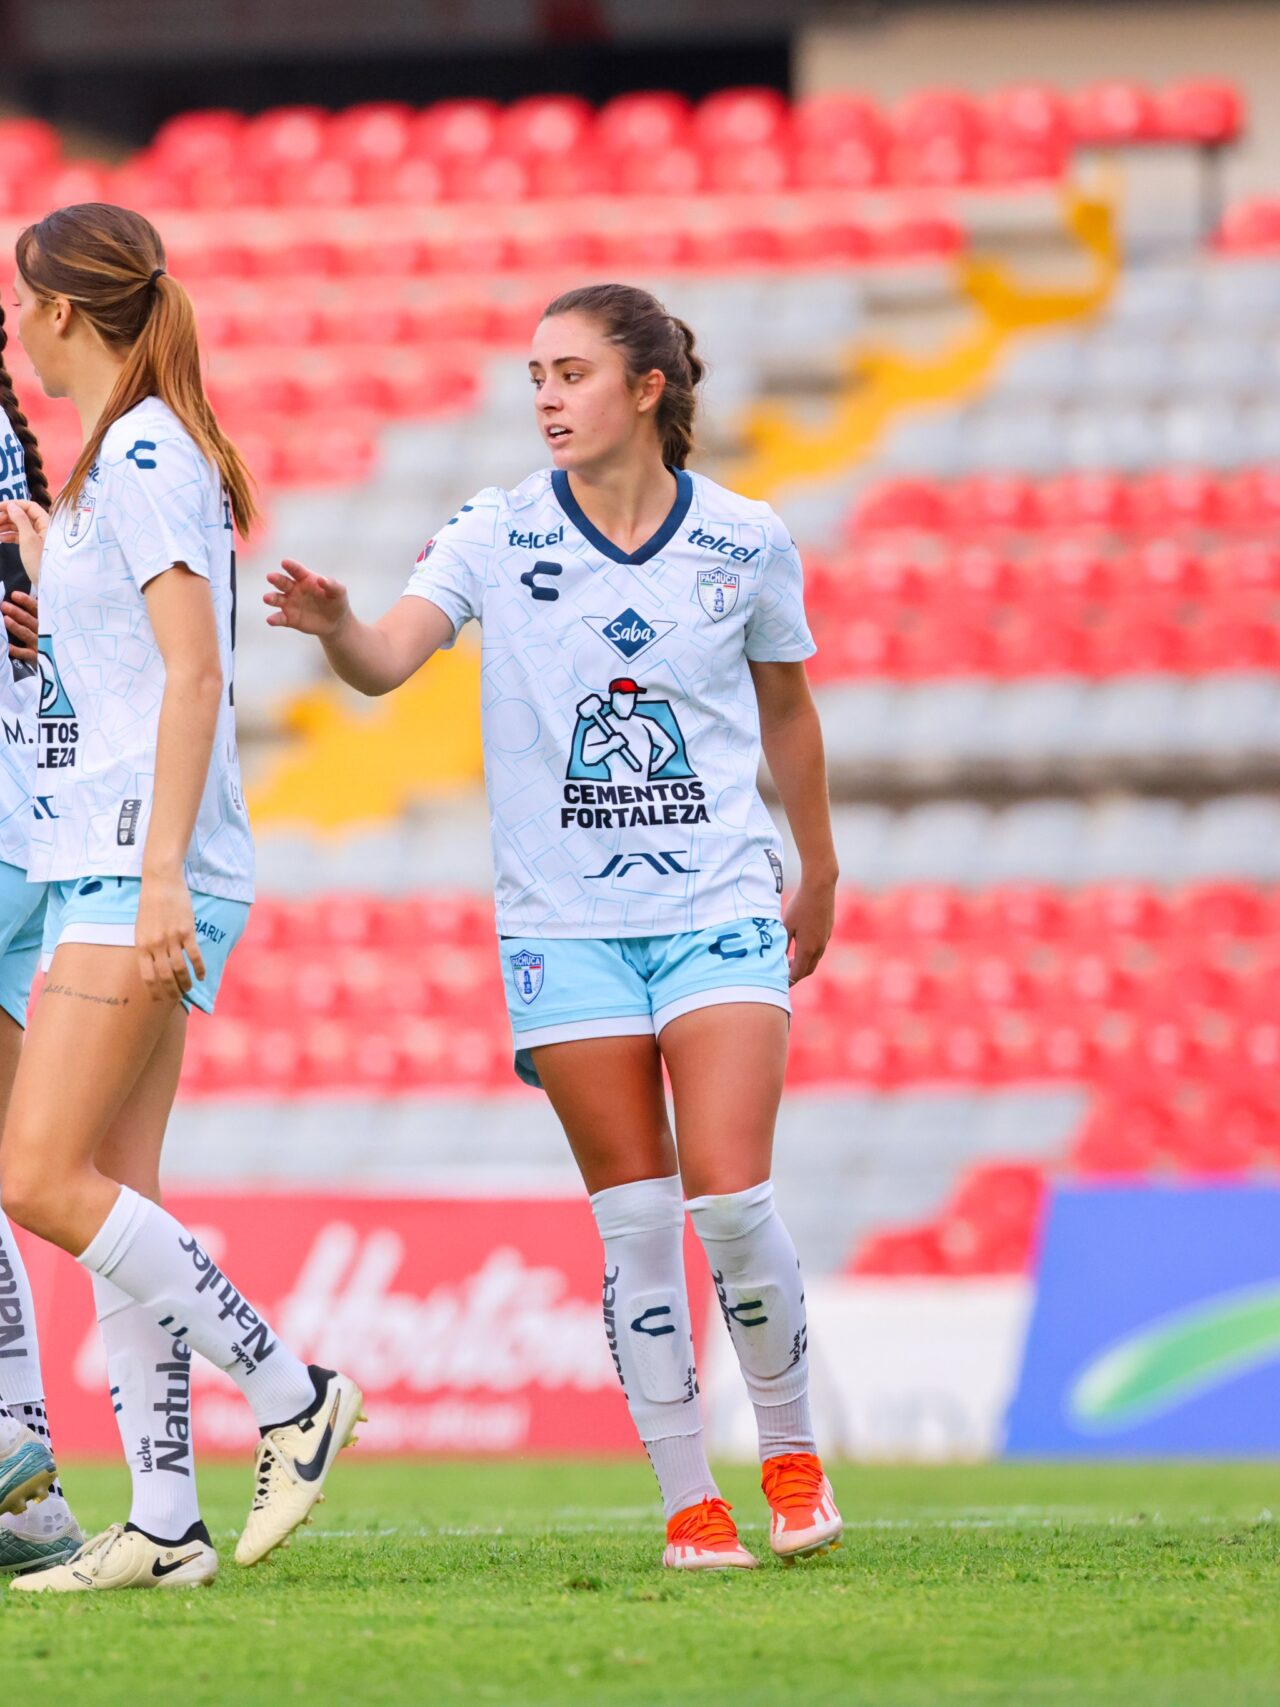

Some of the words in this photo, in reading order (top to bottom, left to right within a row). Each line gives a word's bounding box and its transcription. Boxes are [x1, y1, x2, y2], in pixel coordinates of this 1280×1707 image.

[508, 526, 564, 549] telcel
[687, 527, 760, 564] telcel
[700, 571, 737, 585] PACHUCA
[609, 621, 654, 643] Saba
[563, 781, 705, 805] CEMENTOS
[561, 804, 711, 829] FORTALEZA
[194, 918, 227, 944] HARLY
[231, 1342, 257, 1376] leche
[153, 1338, 192, 1477] Natule
[137, 1435, 153, 1473] leche
